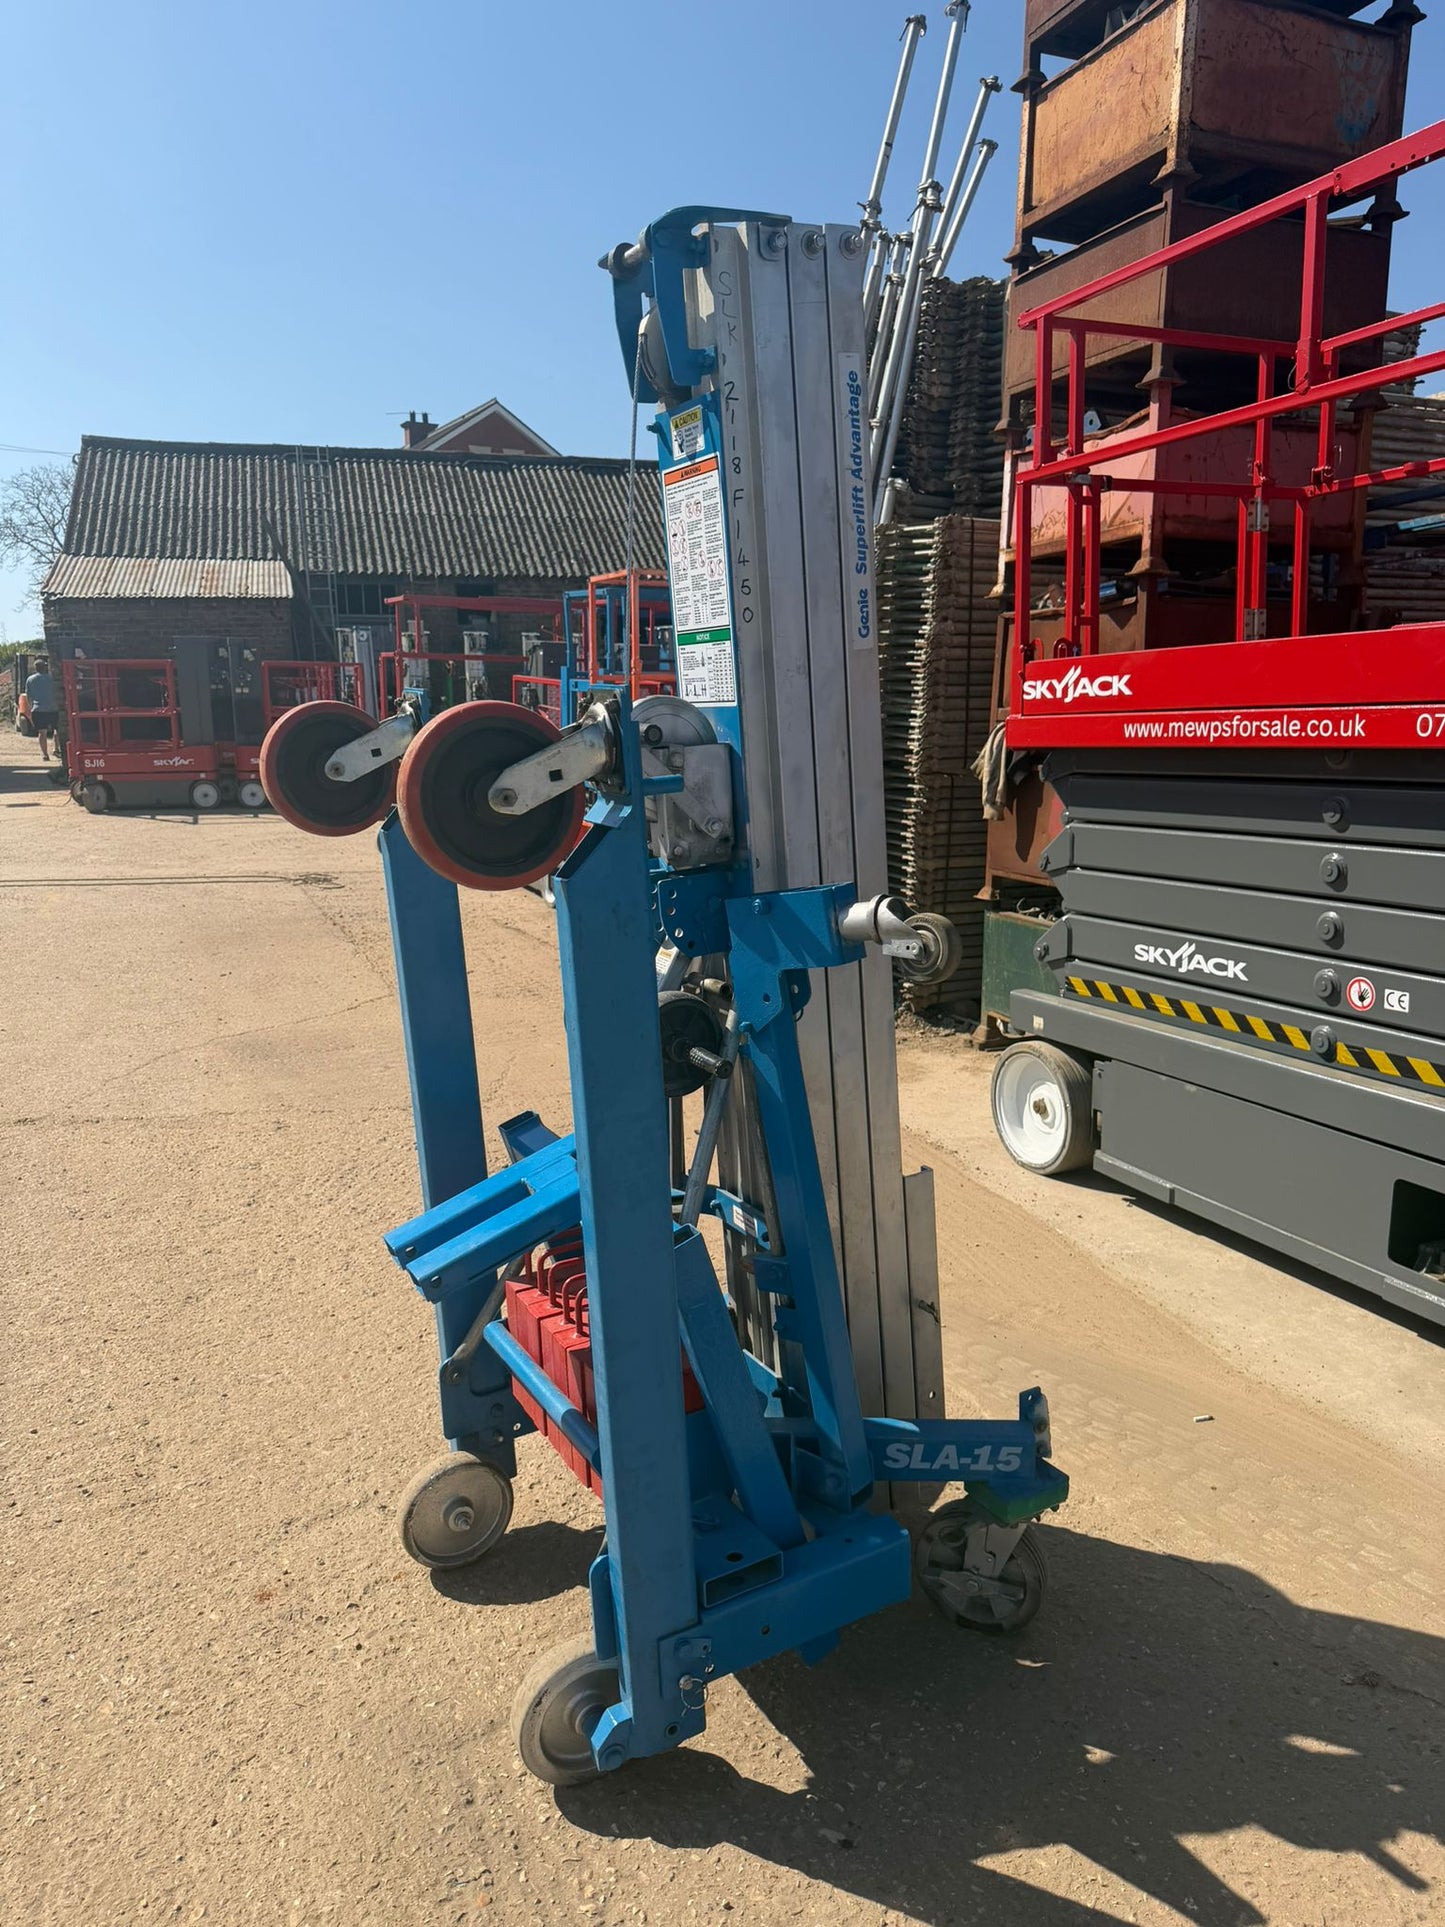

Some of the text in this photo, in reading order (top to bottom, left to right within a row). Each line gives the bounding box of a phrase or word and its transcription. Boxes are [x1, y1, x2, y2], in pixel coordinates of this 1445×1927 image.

[846, 370, 870, 638] Genie Superlift Advantage
[1022, 665, 1133, 703] SKYJACK
[1123, 713, 1366, 742] www.mewpsforsale.co.uk
[84, 759, 105, 768] SJ16
[1134, 941, 1249, 982] SKYJACK
[1386, 991, 1407, 1010] CE
[883, 1442, 1023, 1473] SLA-15
